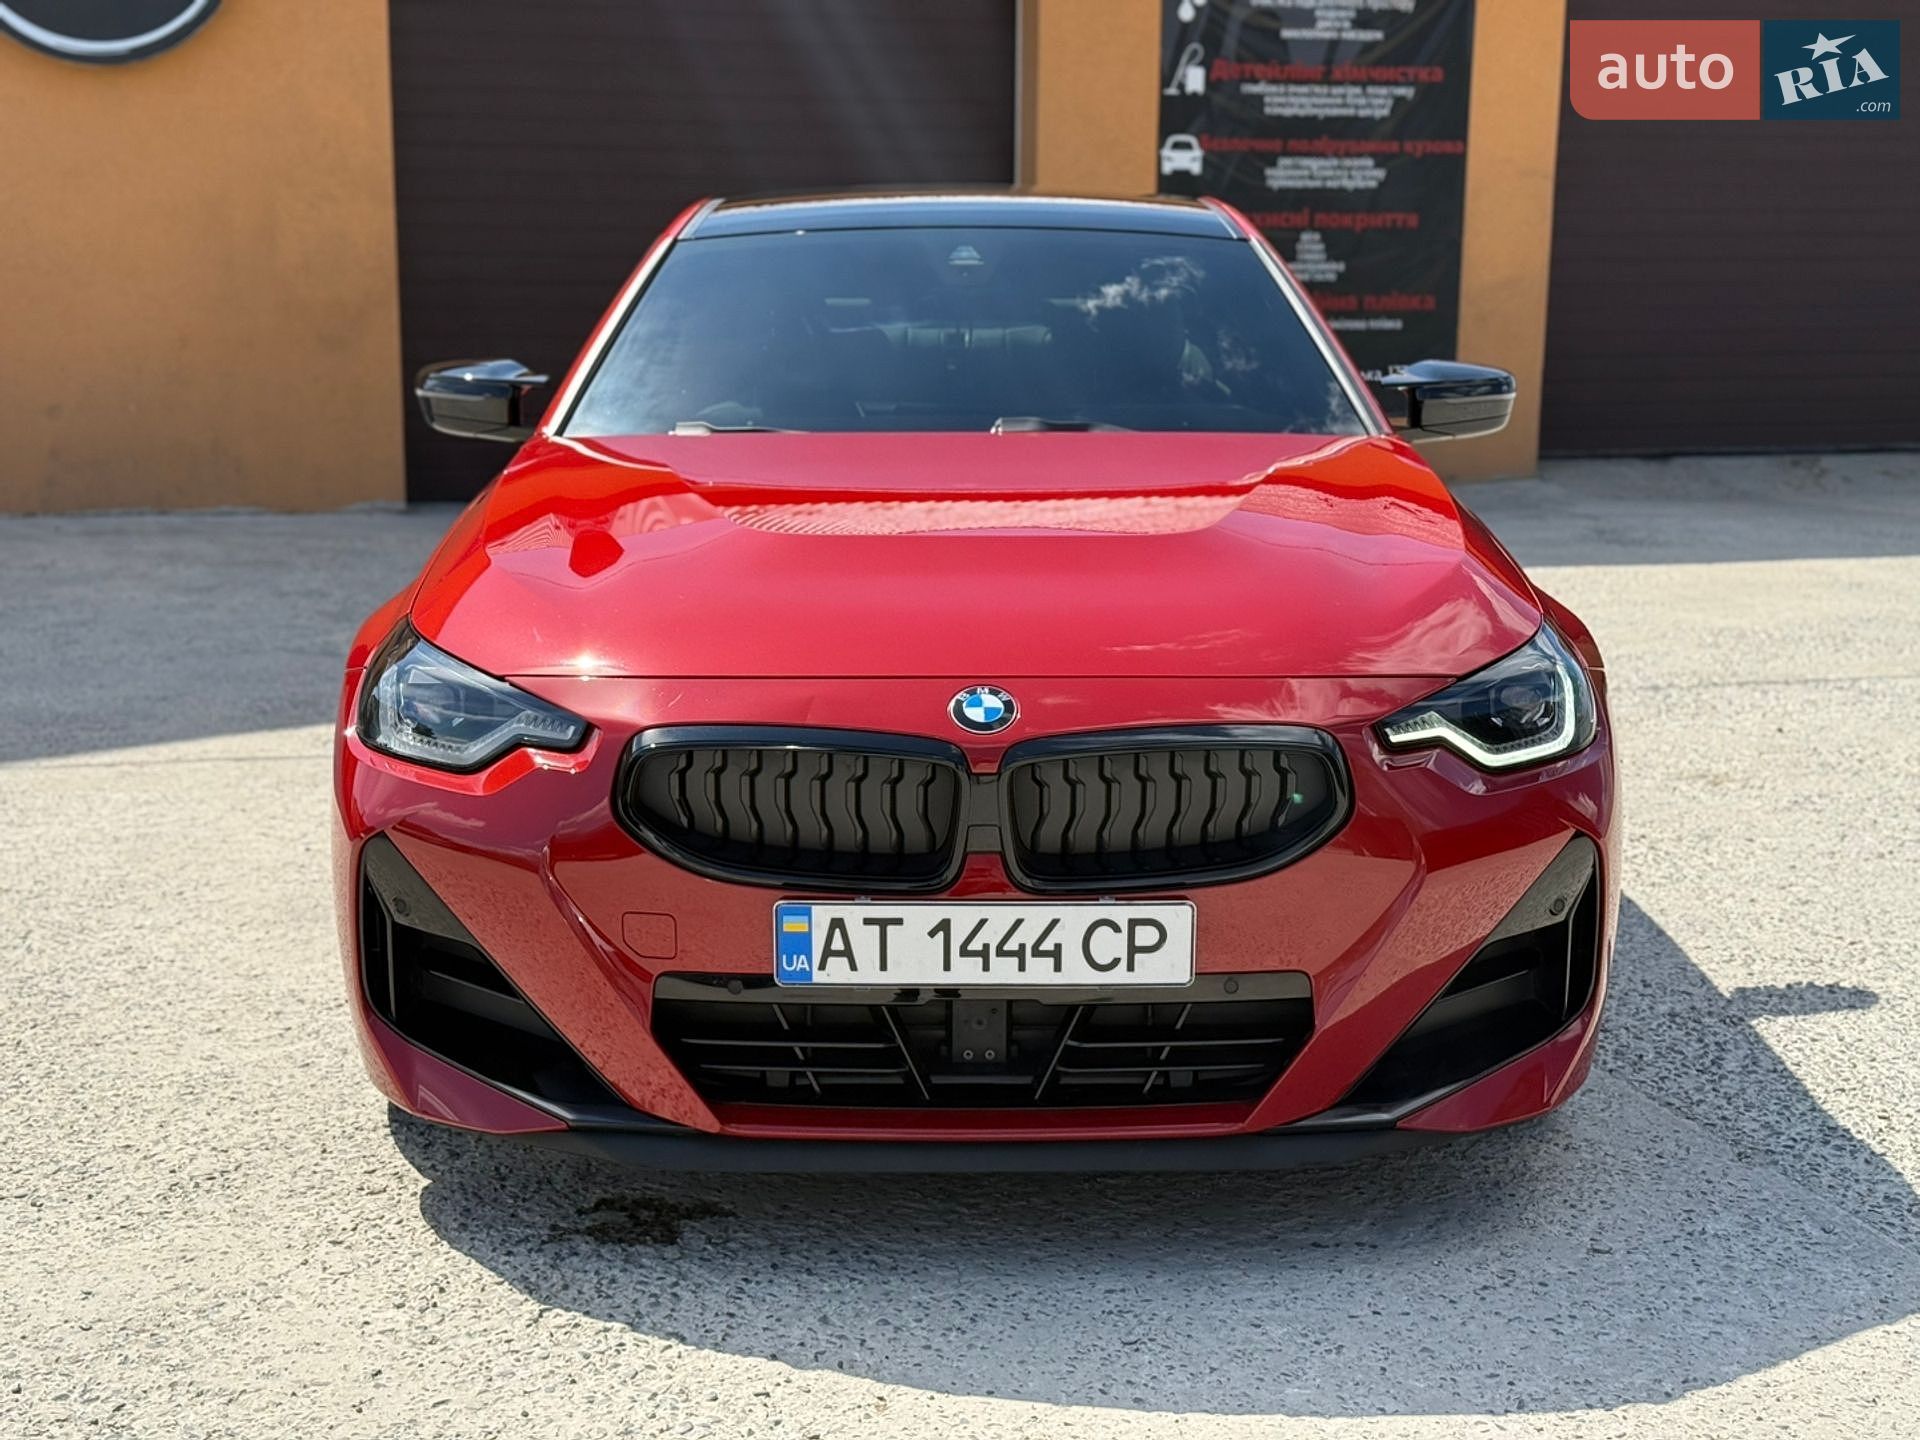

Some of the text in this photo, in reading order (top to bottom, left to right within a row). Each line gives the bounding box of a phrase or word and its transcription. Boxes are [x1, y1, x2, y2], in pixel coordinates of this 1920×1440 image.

[957, 686, 1012, 701] BMW
[817, 917, 1169, 973] AT 1444 CP
[782, 955, 810, 972] UA
